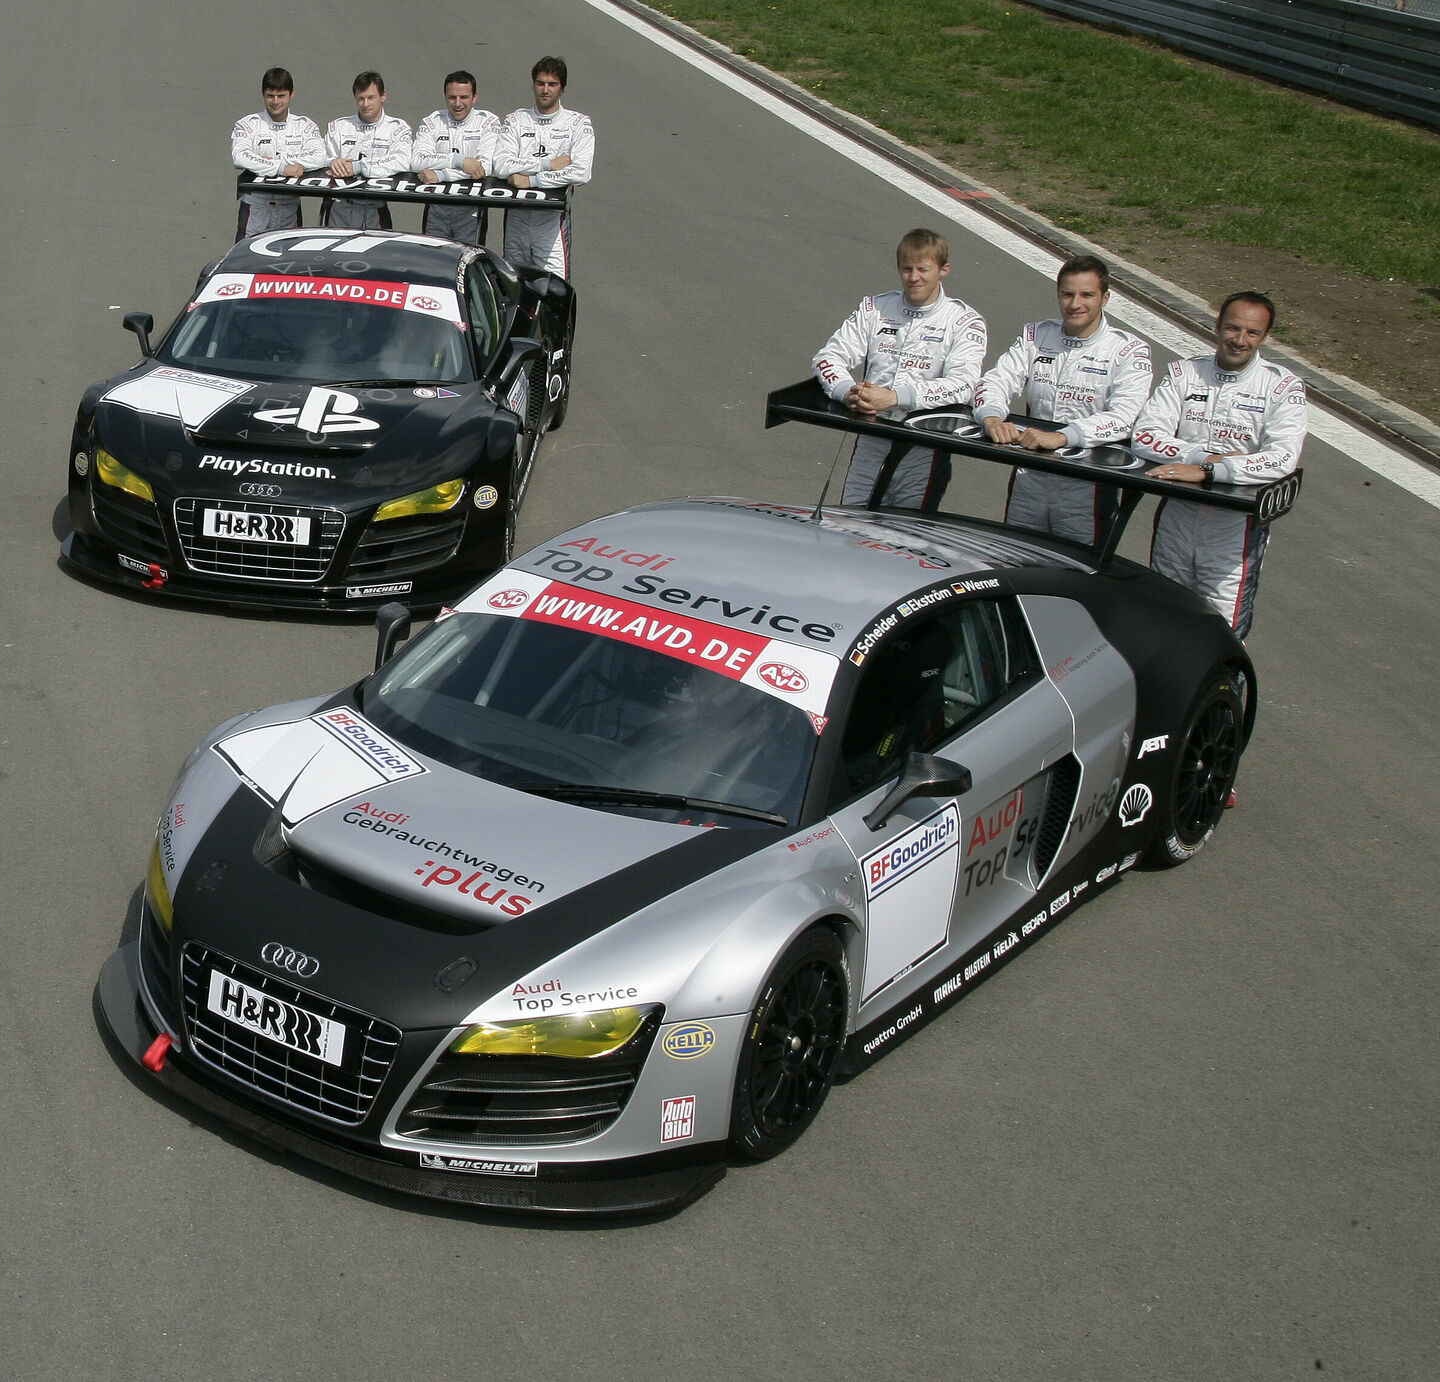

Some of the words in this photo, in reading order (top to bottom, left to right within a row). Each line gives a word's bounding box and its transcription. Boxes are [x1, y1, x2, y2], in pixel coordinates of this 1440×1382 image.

[254, 281, 404, 305] WWW.AVD.DE
[1033, 356, 1056, 364] ABT
[1186, 409, 1206, 417] Audi
[1096, 421, 1117, 432] Audi
[1135, 431, 1181, 458] :pus
[476, 490, 498, 502] HELLA
[559, 536, 676, 572] Audi
[363, 583, 410, 595] MICHELIN
[531, 549, 614, 583] Top
[622, 574, 836, 644] Service
[857, 613, 899, 655] Scheider
[907, 588, 952, 612] Ekström
[961, 578, 1000, 592] Werner
[533, 594, 753, 673] WWW.AVD.DE
[326, 712, 410, 775] BFGoodrich
[1137, 735, 1169, 760] ABT
[174, 803, 186, 828] Audi
[352, 801, 410, 826] Audi
[967, 783, 1025, 857] Audi
[796, 836, 813, 848] Audi
[812, 827, 836, 840] Sport
[162, 830, 176, 872] Service
[342, 811, 546, 894] Gebrauchtwagen
[870, 816, 955, 885] BFGoodrich
[964, 846, 1008, 897] Top
[414, 860, 532, 916] :plus
[511, 978, 562, 997] Audi
[863, 1026, 896, 1054] quattro
[896, 1004, 923, 1030] GmbH
[933, 973, 962, 1004] MAHLE
[964, 951, 991, 981] BILSTEIN
[993, 931, 1020, 959] HELIX
[1022, 910, 1048, 937] RECARO
[514, 994, 555, 1012] Top
[560, 983, 640, 1007] Service
[666, 1030, 715, 1049] HELLA
[663, 1098, 693, 1121] Auto
[664, 1118, 692, 1139] Bild
[448, 1158, 533, 1173] MICHELIN
